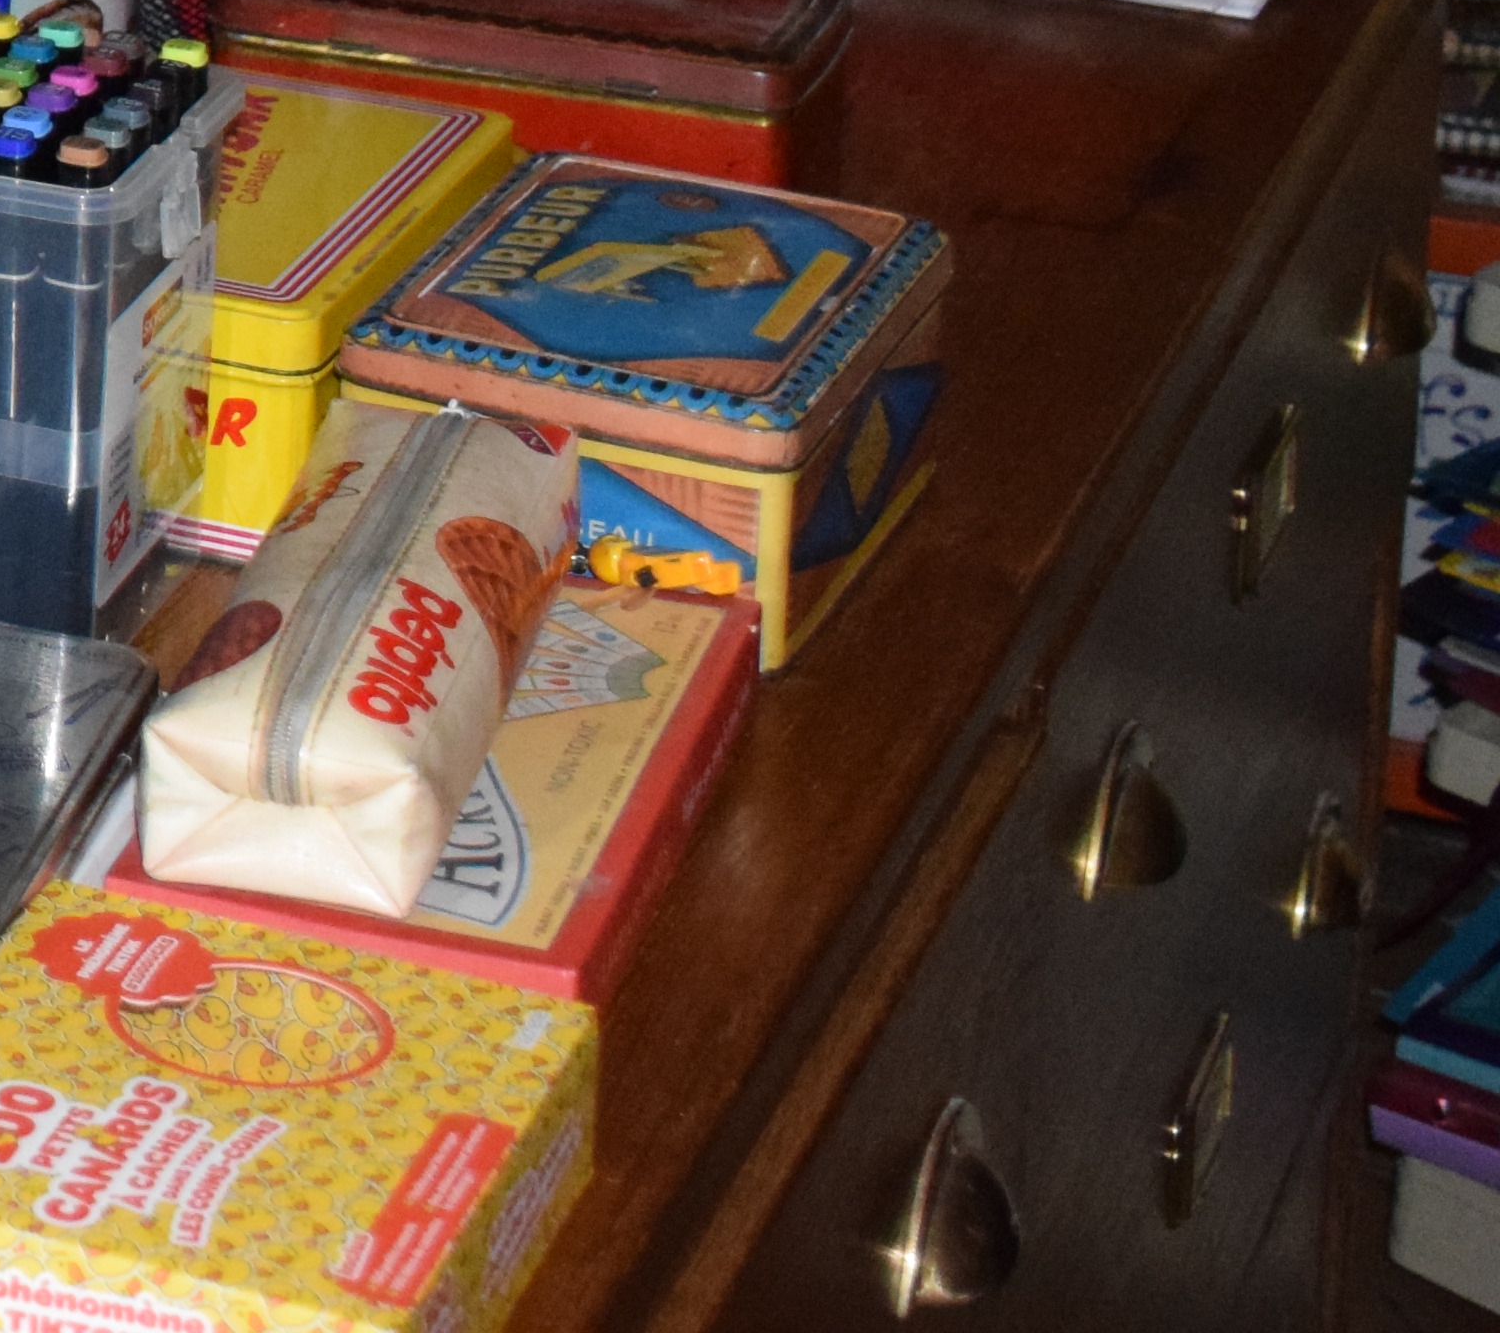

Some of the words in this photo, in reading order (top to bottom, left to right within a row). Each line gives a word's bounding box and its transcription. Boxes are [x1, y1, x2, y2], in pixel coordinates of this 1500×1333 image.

[236, 147, 285, 205] CARAMEL
[347, 575, 464, 727] pépito
[547, 718, 601, 794] NON-TOXIC
[103, 935, 142, 975] TIKTOK
[34, 1107, 97, 1171] PETITS
[41, 1080, 180, 1222] CANARDS
[139, 1120, 206, 1190] CACHER
[176, 1203, 207, 1246] LES
[194, 1119, 287, 1212] COINS-COINS
